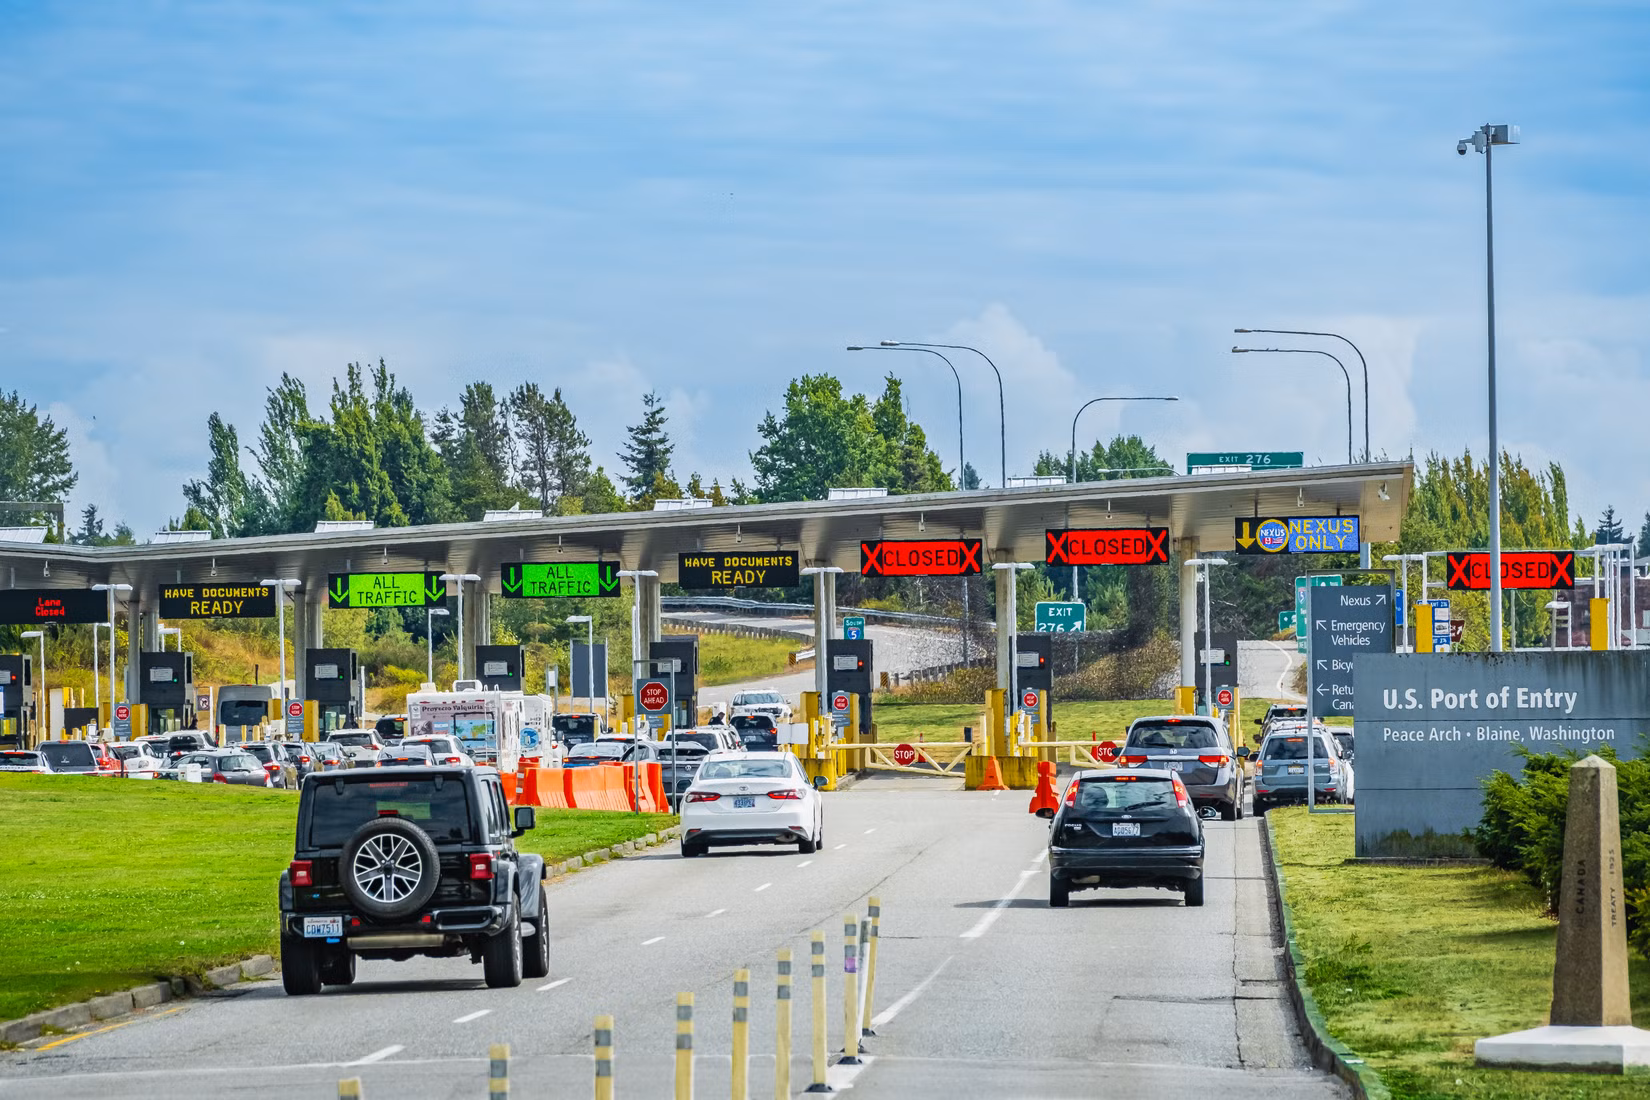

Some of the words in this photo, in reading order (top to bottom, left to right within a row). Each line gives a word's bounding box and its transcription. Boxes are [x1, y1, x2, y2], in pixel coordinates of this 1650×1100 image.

[1246, 454, 1271, 464] 276
[1260, 528, 1285, 537] NEXUS
[1289, 520, 1354, 534] NEXUS
[1070, 538, 1144, 555] CLOSED
[1296, 536, 1347, 550] ONLY
[685, 558, 715, 567] HAVE
[724, 556, 792, 567] DOCUMENTS
[884, 550, 959, 566] CLOSED
[547, 566, 574, 578] ALL
[711, 570, 766, 584] READY
[373, 576, 400, 589] ALL
[530, 581, 591, 594] TRAFFIC
[165, 589, 195, 599] HAVE
[202, 587, 269, 598] DOCUMENTS
[357, 591, 417, 604] TRAFFIC
[38, 598, 61, 606] Lane
[1340, 595, 1371, 606] Nexus
[35, 606, 65, 616] Closed
[190, 600, 244, 615] READY
[1049, 608, 1072, 616] EXIT
[1039, 622, 1065, 632] 276
[1331, 620, 1385, 634] Emergency
[852, 630, 857, 640] 5
[1331, 634, 1371, 646] Vehicles
[1332, 684, 1354, 695] Retu
[1383, 688, 1424, 710] U.S.
[1431, 689, 1478, 709] Port
[1486, 686, 1510, 709] of
[1517, 687, 1578, 714] Entry
[1383, 728, 1424, 741] Peace
[1429, 727, 1461, 741] Arch
[1476, 727, 1525, 742] Blaine,
[1529, 726, 1615, 743] Washington
[895, 750, 914, 759] STOP
[1098, 748, 1112, 756] STO
[1575, 860, 1586, 914] CANADA
